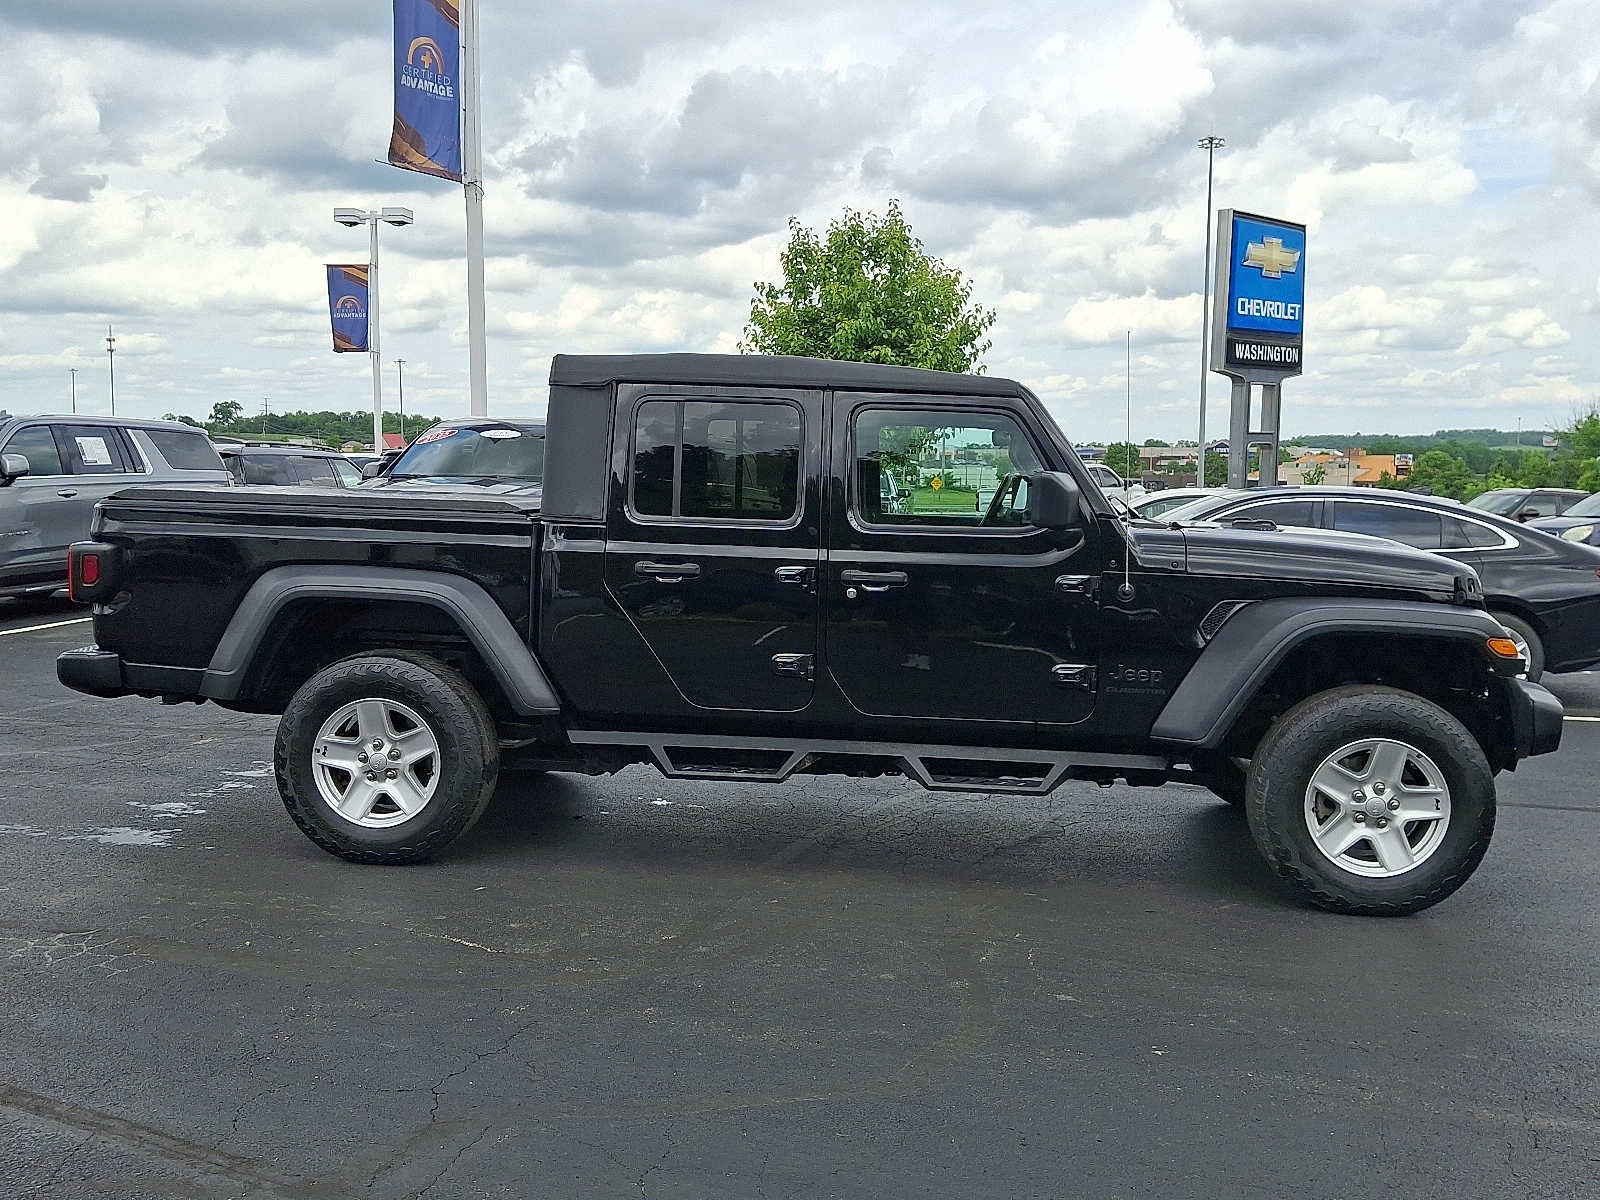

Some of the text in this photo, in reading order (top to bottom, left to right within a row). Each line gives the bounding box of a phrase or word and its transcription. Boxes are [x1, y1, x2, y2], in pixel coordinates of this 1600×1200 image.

[400, 74, 454, 97] ADVANTAGE
[402, 64, 451, 86] CERTIFIED
[1237, 297, 1301, 320] CHEVROLET
[1235, 343, 1299, 363] WASHINGTON
[1108, 664, 1162, 685] Jeep
